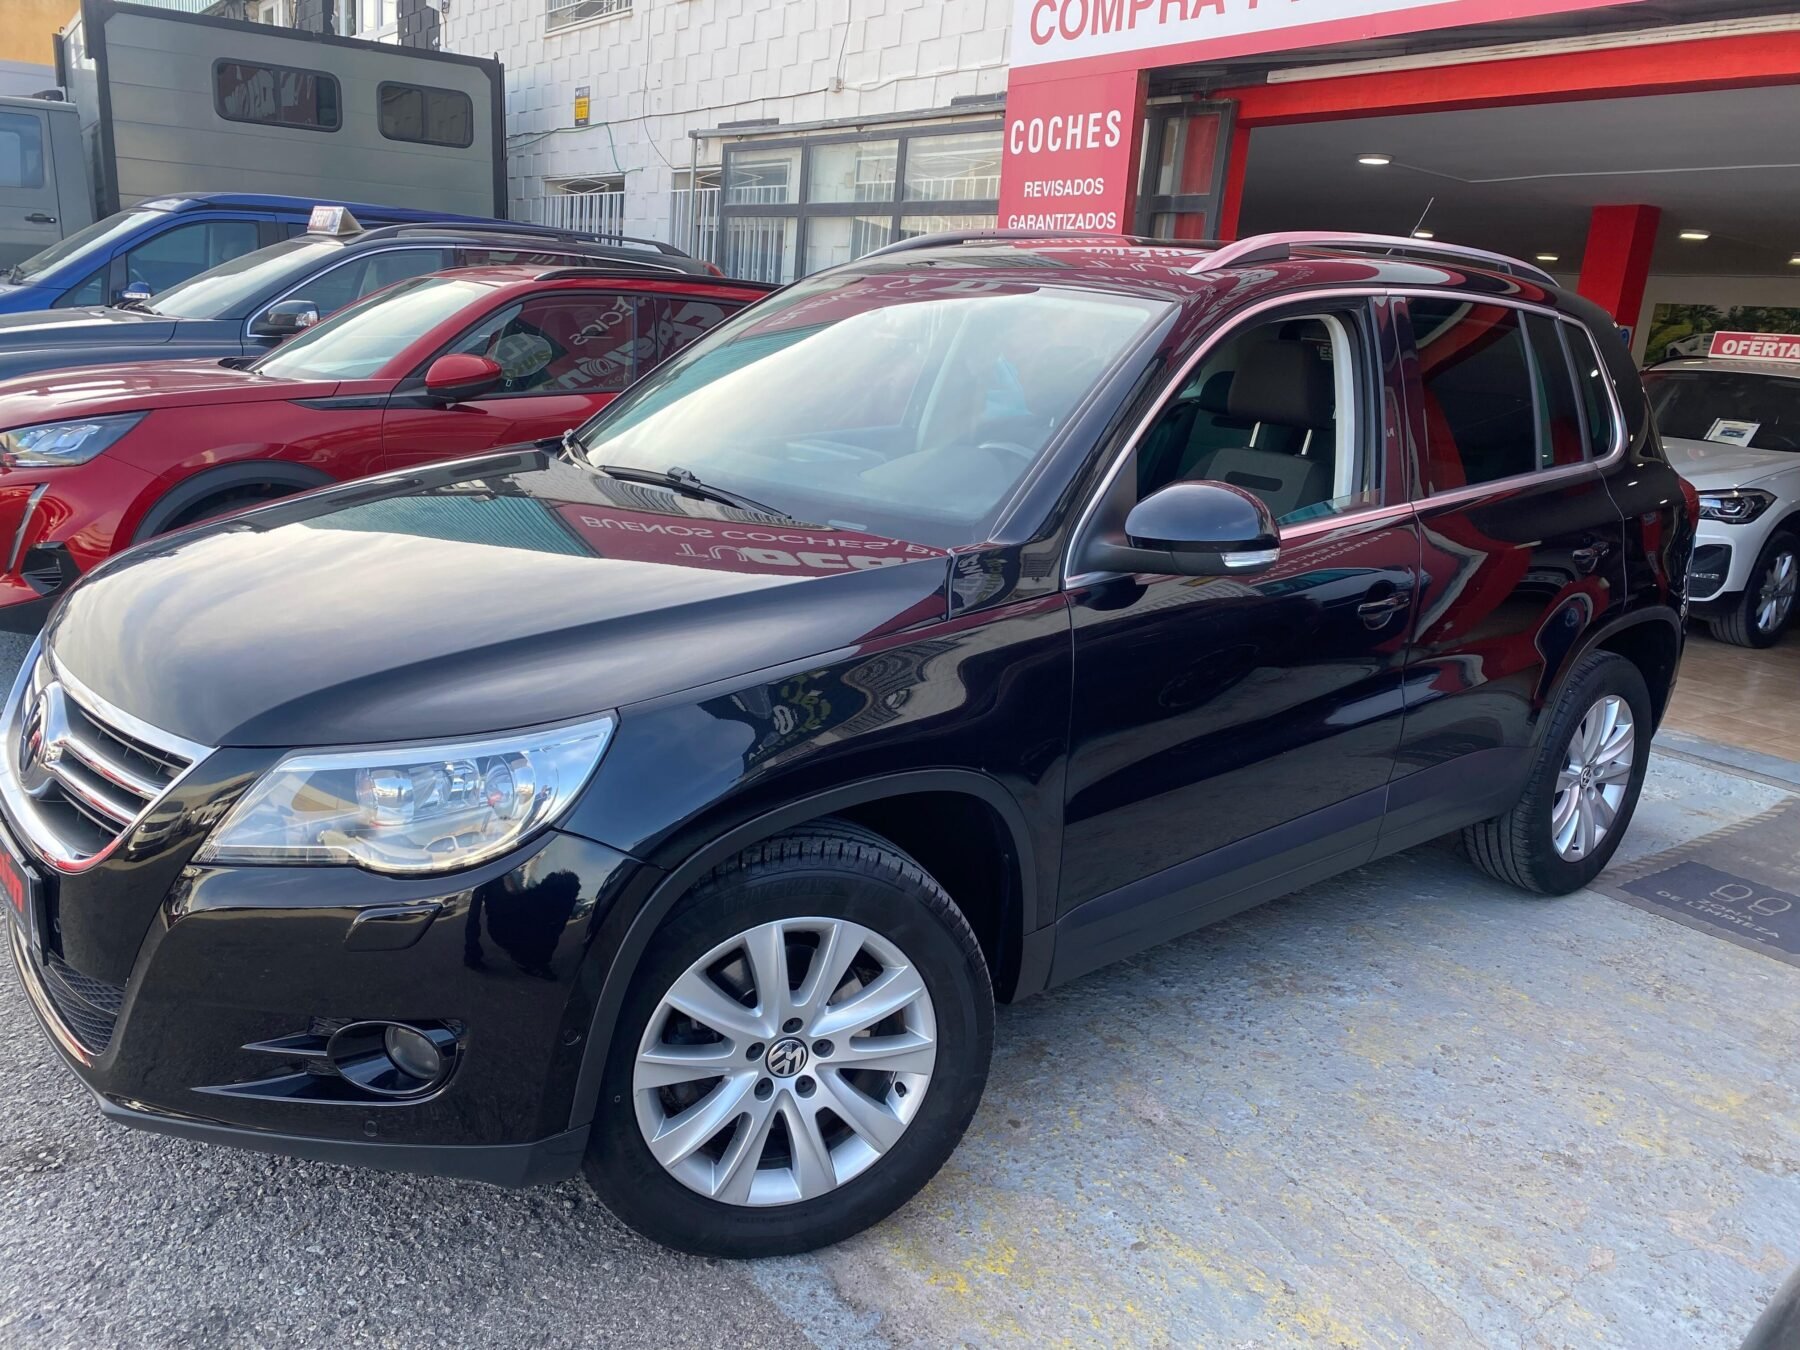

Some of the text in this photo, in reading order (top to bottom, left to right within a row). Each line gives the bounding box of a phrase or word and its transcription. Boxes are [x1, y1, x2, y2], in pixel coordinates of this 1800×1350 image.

[1010, 110, 1121, 155] COCHES
[1023, 177, 1104, 198] REVISADOS
[1008, 211, 1117, 230] GARANTIZADOS
[1722, 339, 1800, 357] OFERTA
[1655, 890, 1682, 902] DE
